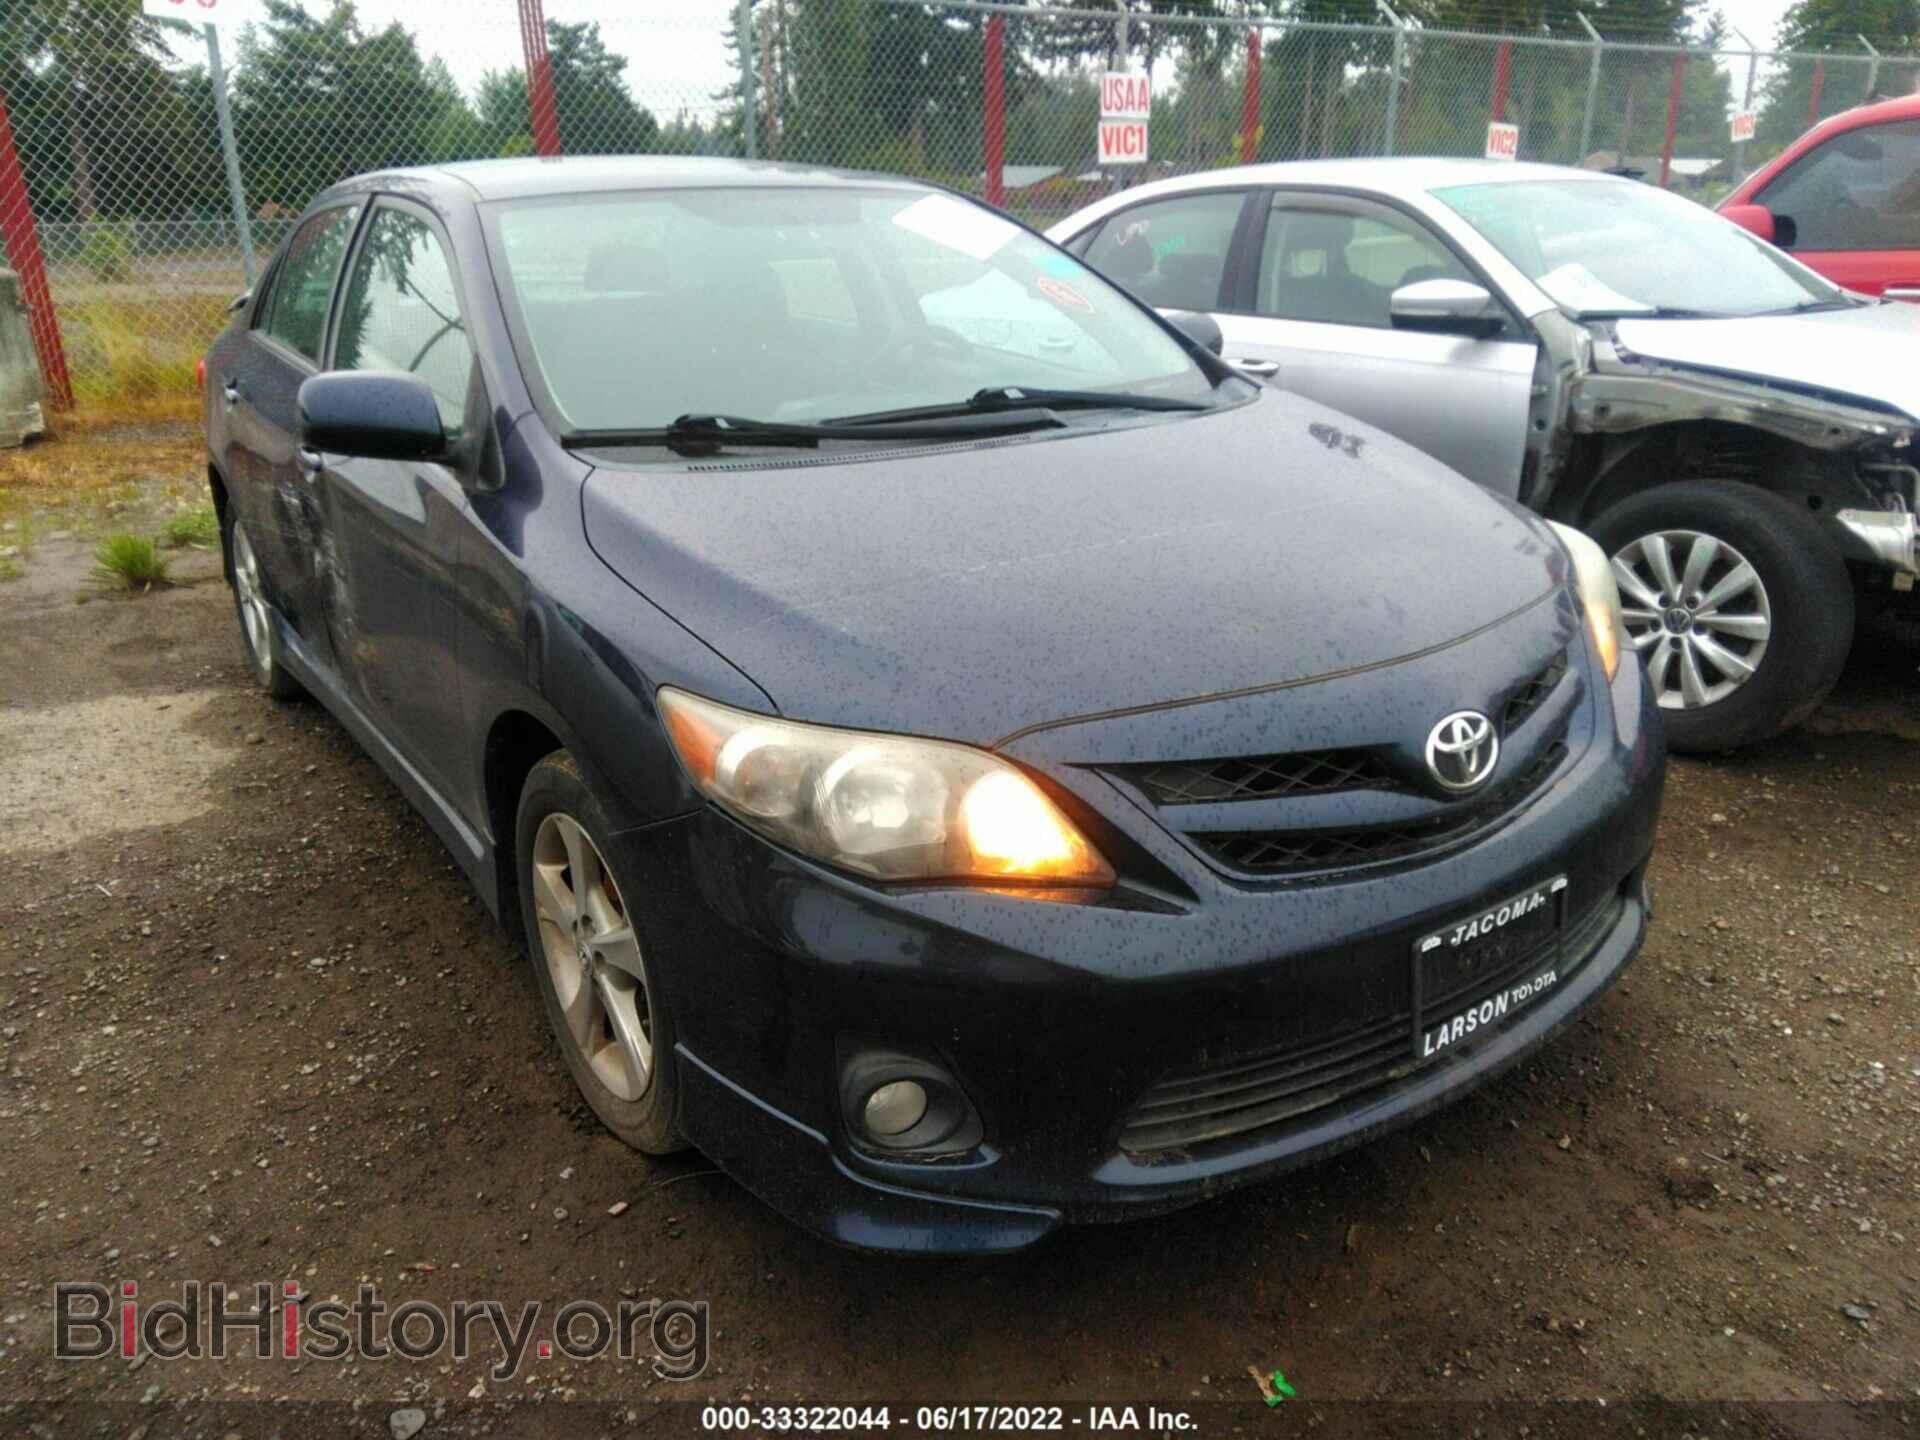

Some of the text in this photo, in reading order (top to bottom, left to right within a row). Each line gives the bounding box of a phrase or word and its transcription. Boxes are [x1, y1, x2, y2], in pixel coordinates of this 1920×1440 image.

[1103, 78, 1148, 111] USAA
[1102, 125, 1144, 156] VIC1
[1423, 991, 1510, 1057] LARSON
